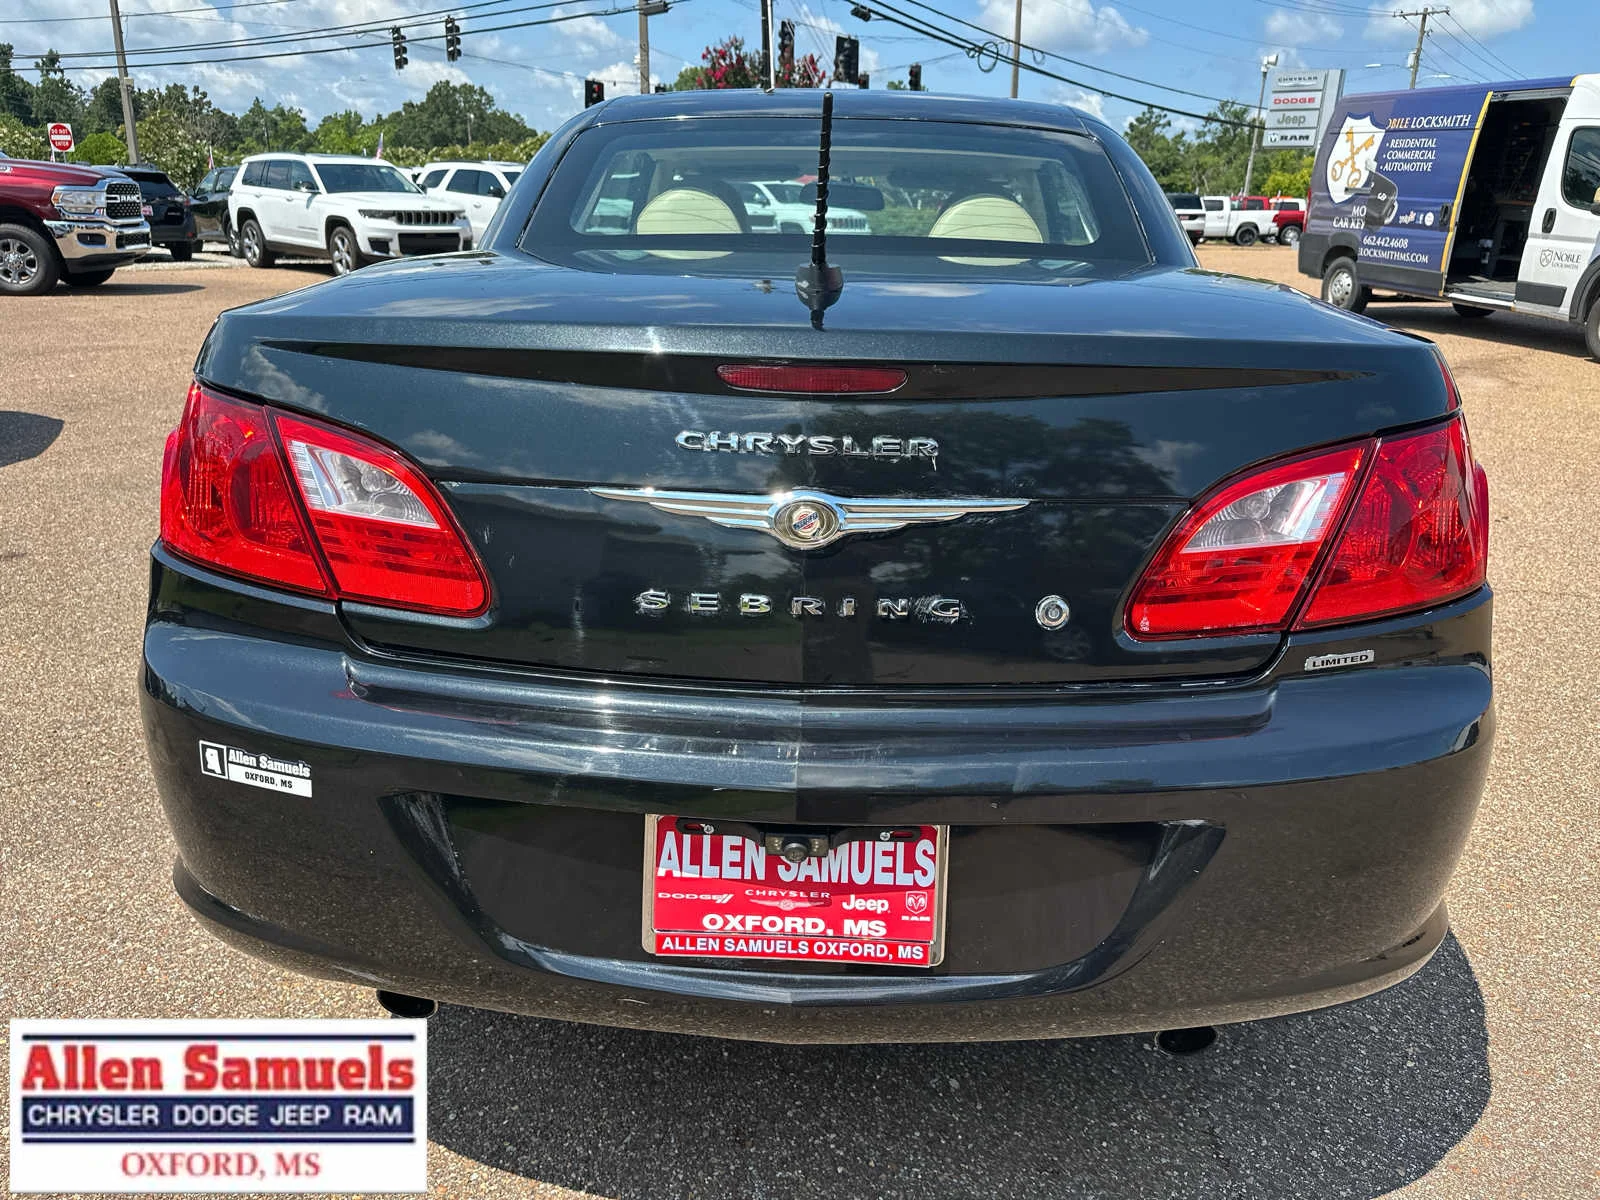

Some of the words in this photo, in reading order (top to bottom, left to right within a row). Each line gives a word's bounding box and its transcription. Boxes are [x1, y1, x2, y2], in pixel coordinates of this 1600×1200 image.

[1277, 113, 1306, 126] Jeep
[1410, 114, 1472, 129] LOCKSMITH
[1390, 138, 1437, 148] RESIDENTIAL
[1386, 150, 1436, 160] COMMERCIAL
[1382, 162, 1433, 172] AUTOMOTIVE
[1333, 216, 1349, 229] CAR
[675, 430, 939, 457] CHRYSLER
[635, 590, 962, 619] SEBRING
[1312, 654, 1369, 668] LIMITED
[228, 749, 257, 768] Allen
[259, 755, 311, 778] Samuels
[244, 771, 278, 787] OXFORD,
[280, 779, 293, 789] MS
[657, 831, 766, 880] ALLEN
[777, 839, 936, 887] SAMUELS
[658, 892, 727, 901] DODGE
[745, 889, 831, 899] CHRYSLER
[842, 894, 889, 913] Jeep
[702, 914, 834, 937] OXFORD,
[843, 919, 887, 937] MS
[662, 937, 720, 953] ALLEN
[723, 938, 809, 955] SAMUELS
[813, 941, 893, 960] OXFORD,
[897, 945, 924, 960] MS
